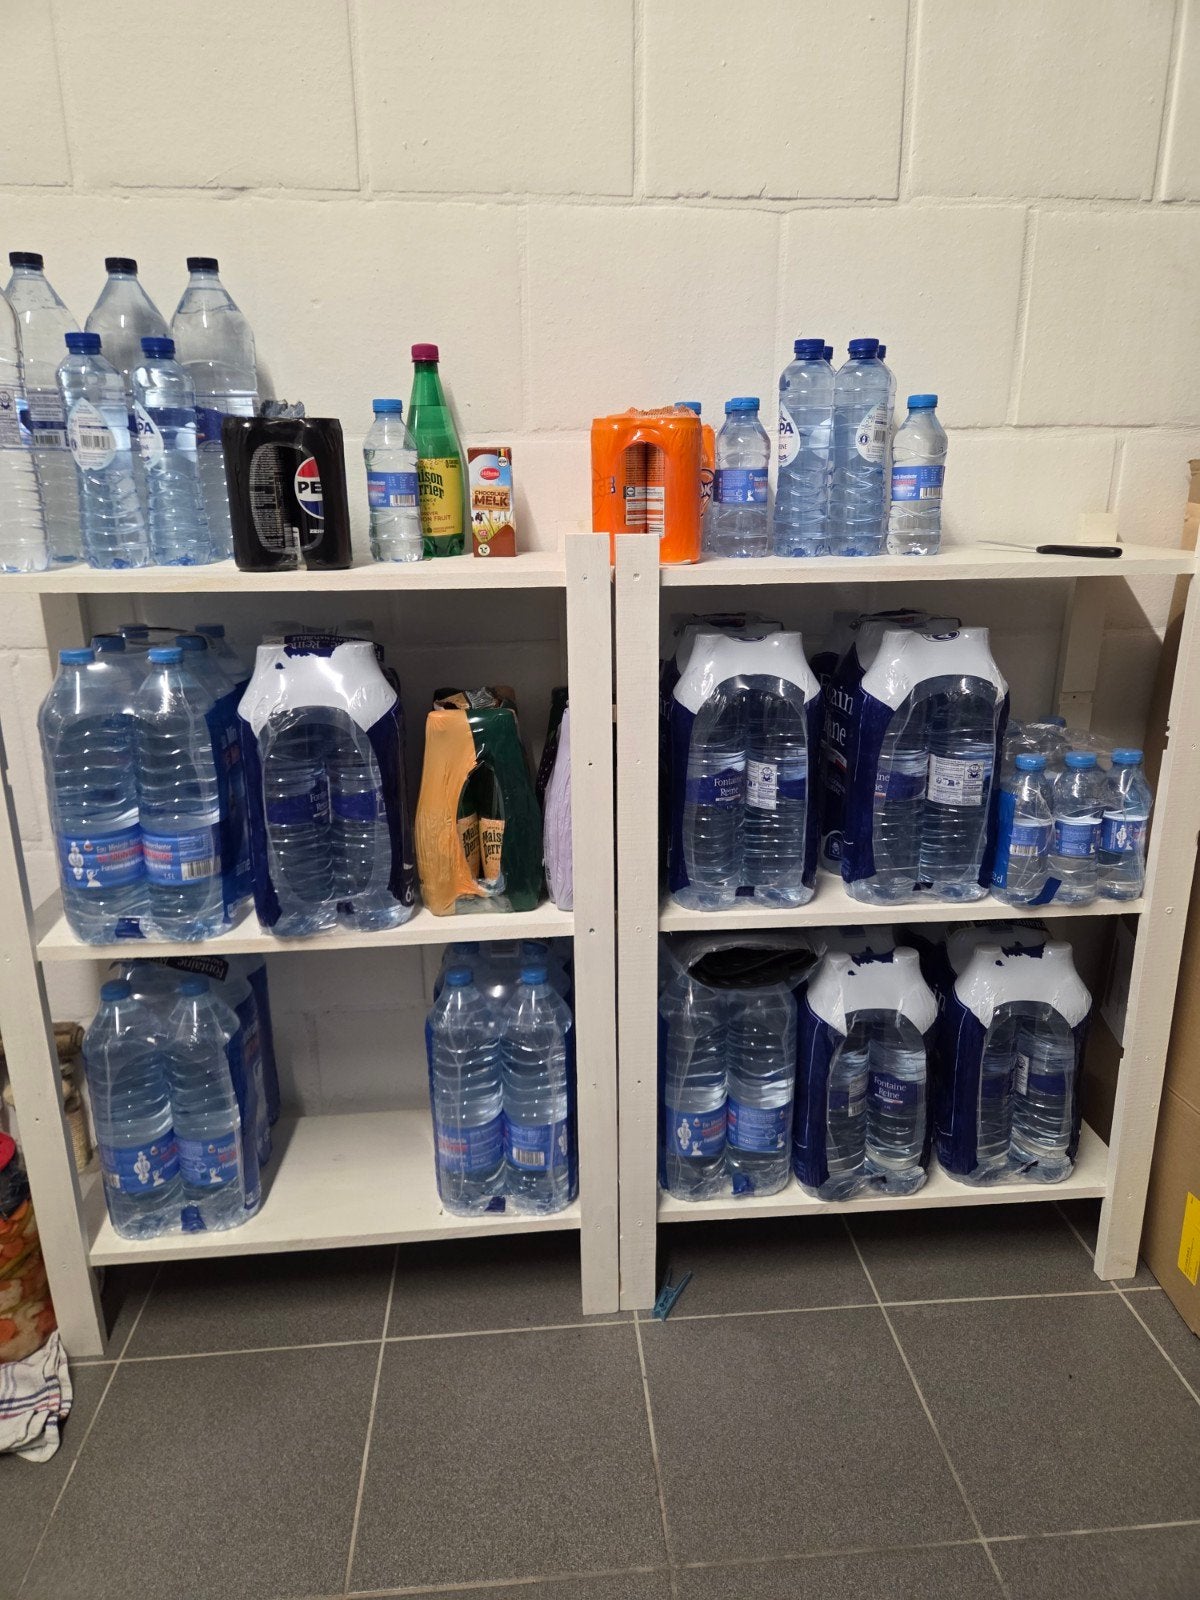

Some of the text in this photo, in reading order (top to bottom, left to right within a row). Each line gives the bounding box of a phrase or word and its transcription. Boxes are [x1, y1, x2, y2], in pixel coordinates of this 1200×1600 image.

[138, 422, 155, 434] PA
[779, 422, 794, 434] PA
[419, 470, 443, 486] ison
[298, 482, 322, 494] PE
[419, 482, 444, 499] rrier
[475, 495, 508, 506] MELK
[482, 830, 502, 843] Mais
[483, 844, 501, 864] Perr
[874, 1076, 907, 1091] Fontaine
[878, 1087, 900, 1099] Reine
